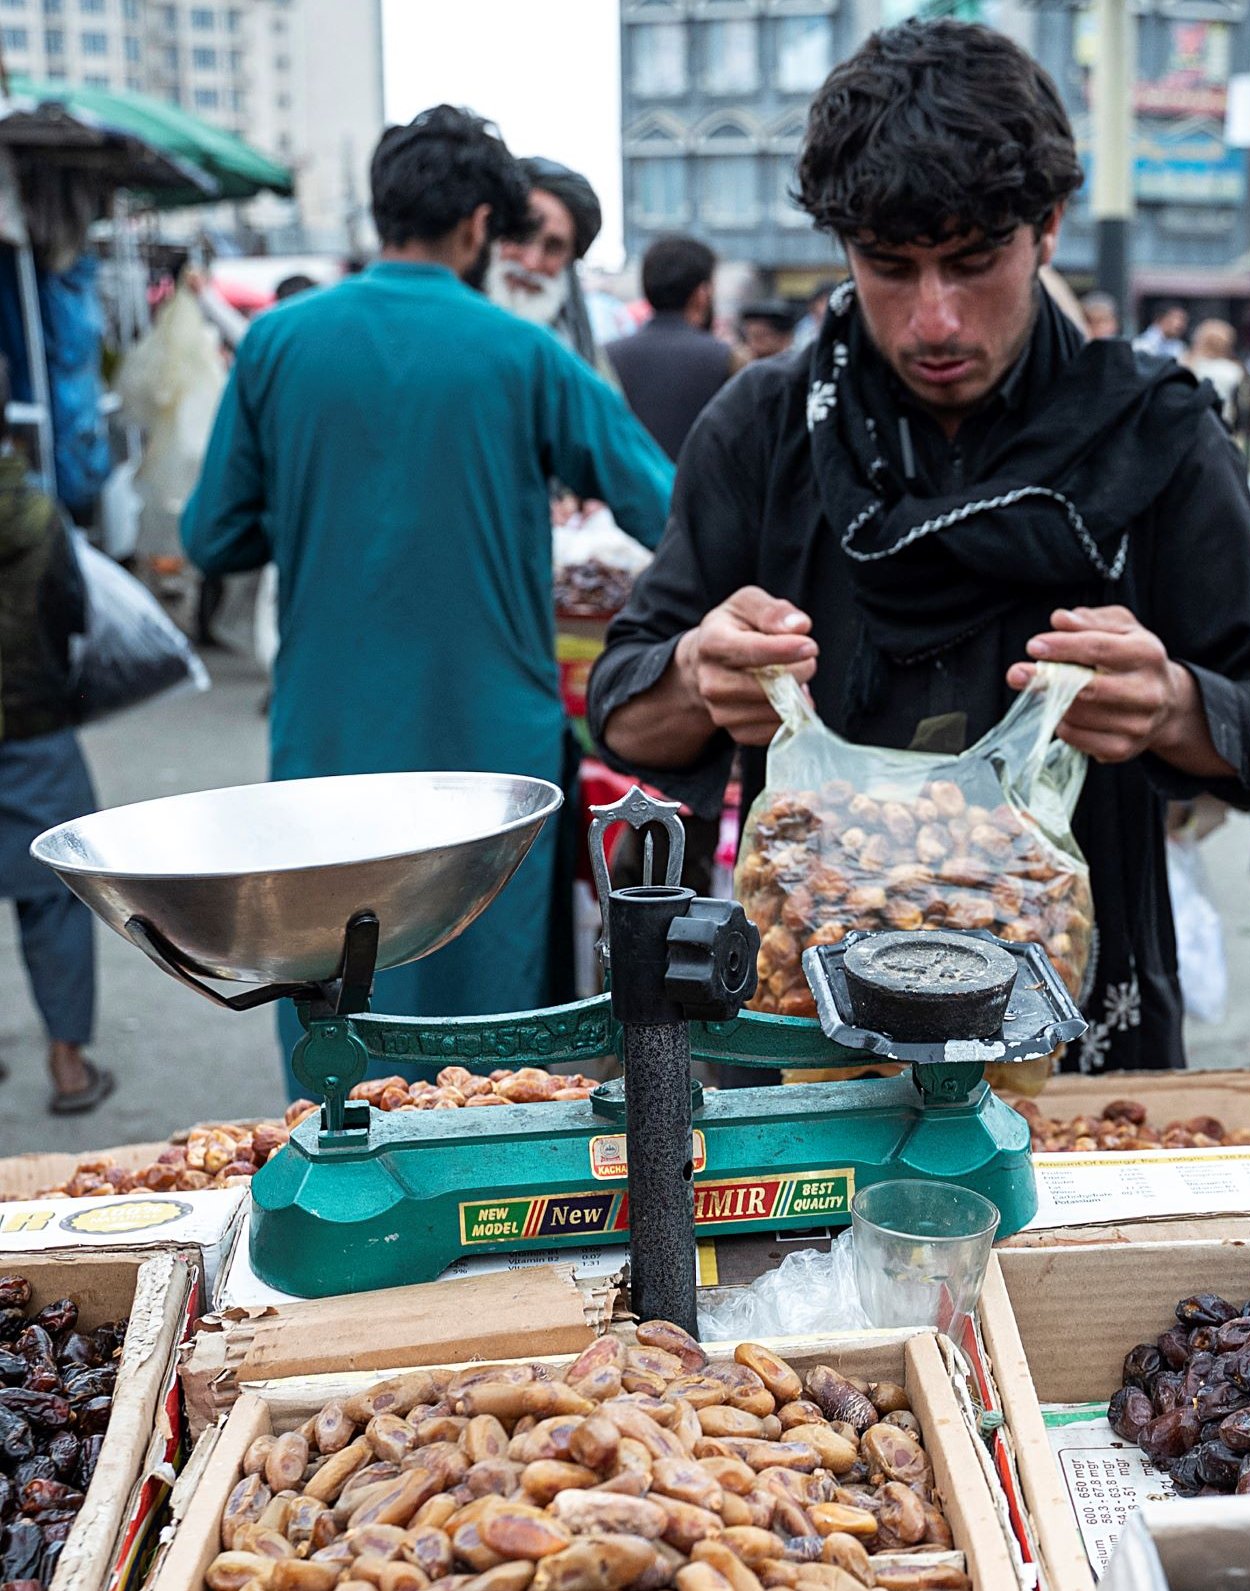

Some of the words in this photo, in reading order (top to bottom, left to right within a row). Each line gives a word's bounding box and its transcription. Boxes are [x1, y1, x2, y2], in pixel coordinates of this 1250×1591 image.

[597, 1165, 628, 1175] KACHA
[802, 1182, 835, 1196] BEST
[793, 1196, 844, 1212] QUALITY
[478, 1207, 509, 1222] NEW
[550, 1206, 603, 1226] New
[472, 1222, 519, 1237] MODEL
[508, 1257, 545, 1265] Vitamin
[547, 1255, 560, 1263] B2
[1072, 1458, 1085, 1478] mgr
[1087, 1460, 1099, 1478] mgr
[1102, 1460, 1115, 1478] mgr
[1116, 1458, 1130, 1476] mgr
[1076, 1481, 1091, 1498] 650
[1090, 1479, 1105, 1498] 67.8
[1106, 1479, 1121, 1498] 63.8
[1083, 1507, 1098, 1525] 600
[1098, 1505, 1113, 1524] 58.3
